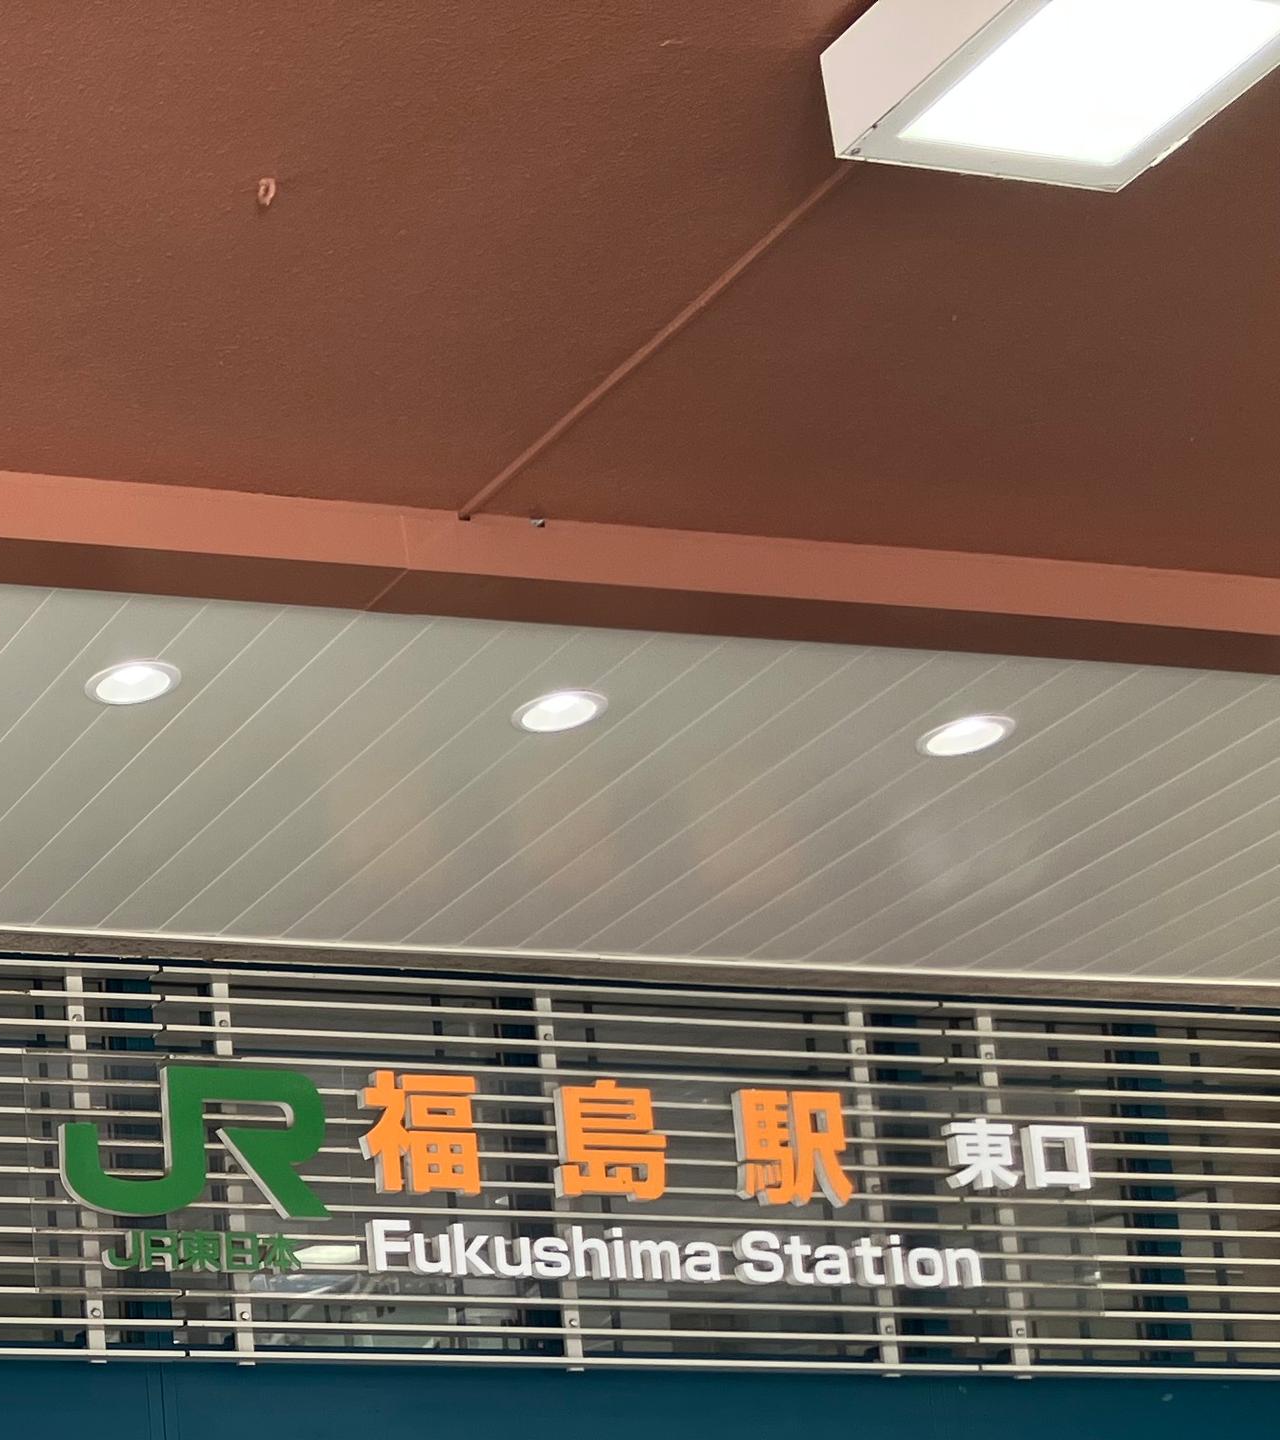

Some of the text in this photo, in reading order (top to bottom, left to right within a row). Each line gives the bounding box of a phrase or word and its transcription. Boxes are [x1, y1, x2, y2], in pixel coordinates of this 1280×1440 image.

[57, 1065, 333, 1220] JR
[357, 1070, 1093, 1208] 福島駅 東口
[101, 1229, 302, 1273] JR東日本
[365, 1218, 984, 1290] Fukushima Station
